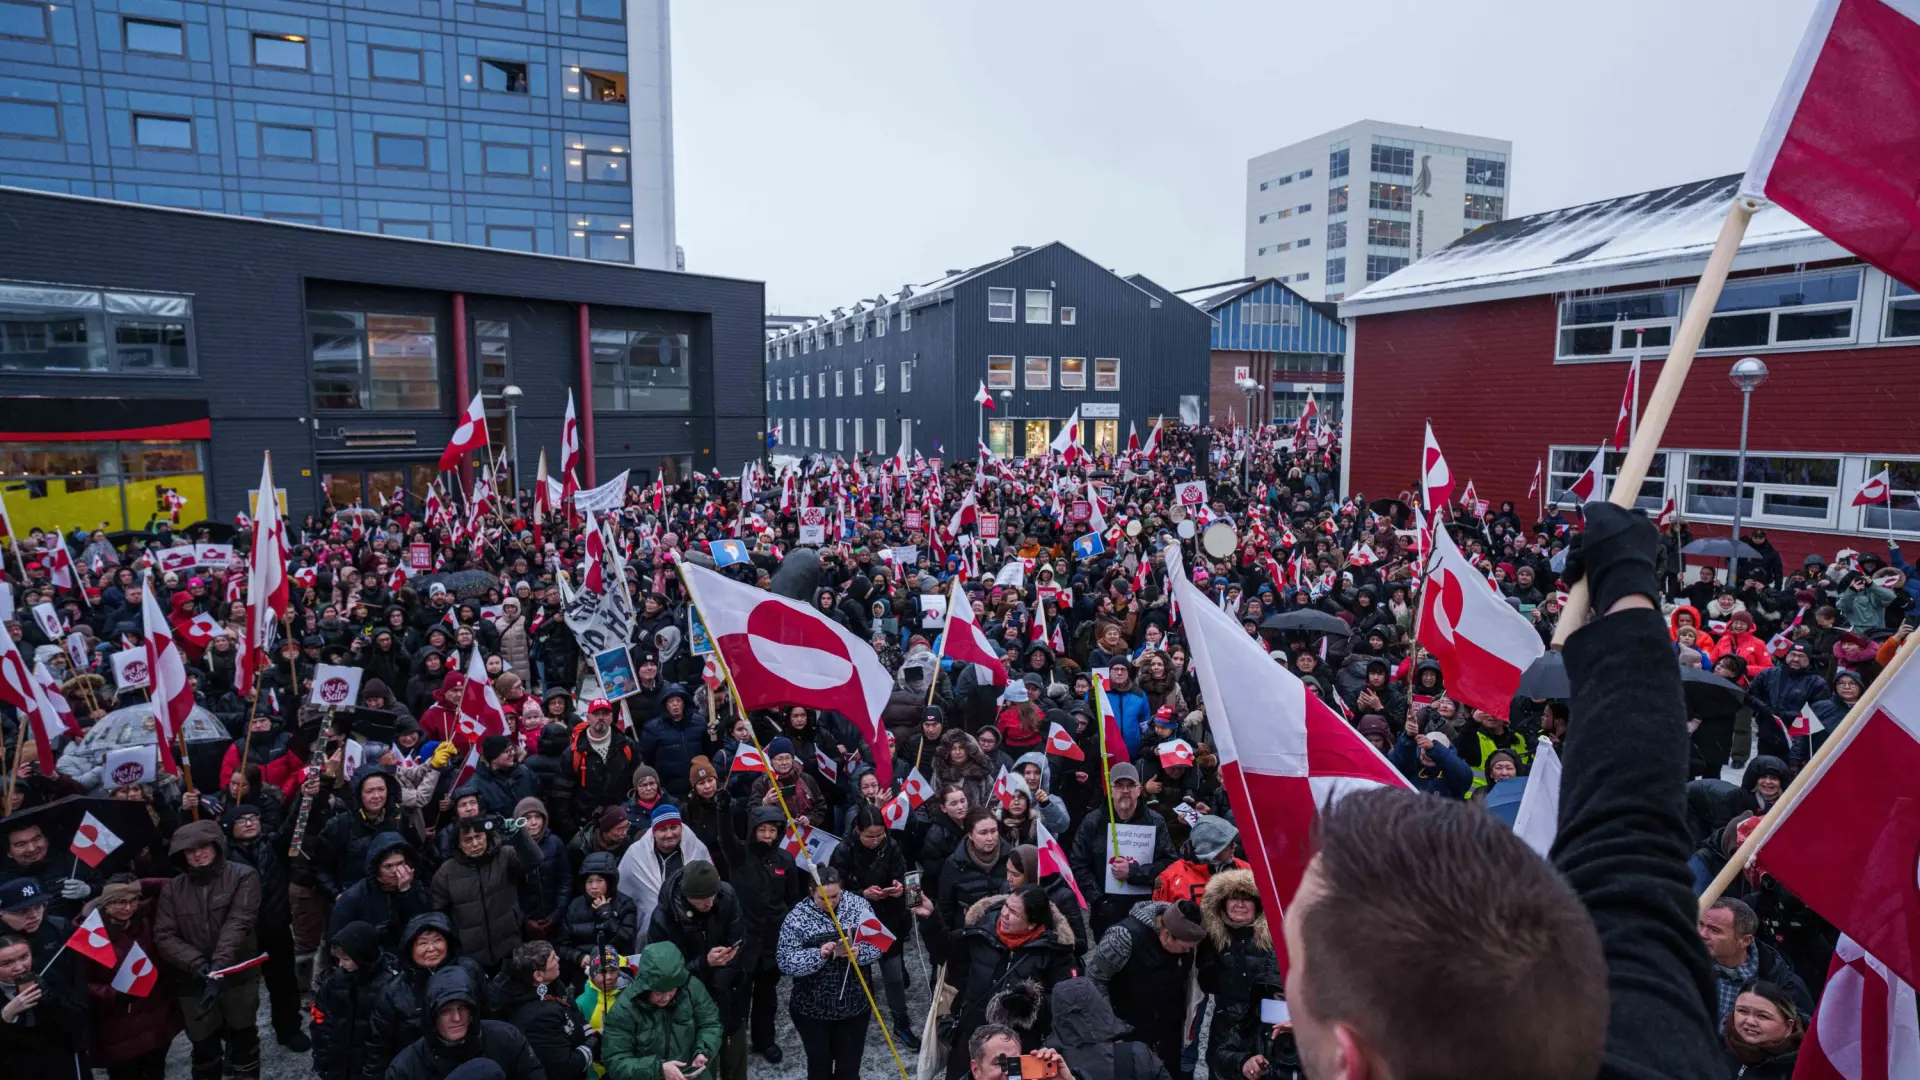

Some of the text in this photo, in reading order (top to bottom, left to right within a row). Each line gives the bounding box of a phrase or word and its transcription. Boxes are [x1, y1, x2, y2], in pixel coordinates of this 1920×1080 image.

[129, 669, 148, 683] Sale
[321, 682, 348, 693] Not for
[325, 690, 347, 701] Sale
[119, 772, 142, 785] Sale
